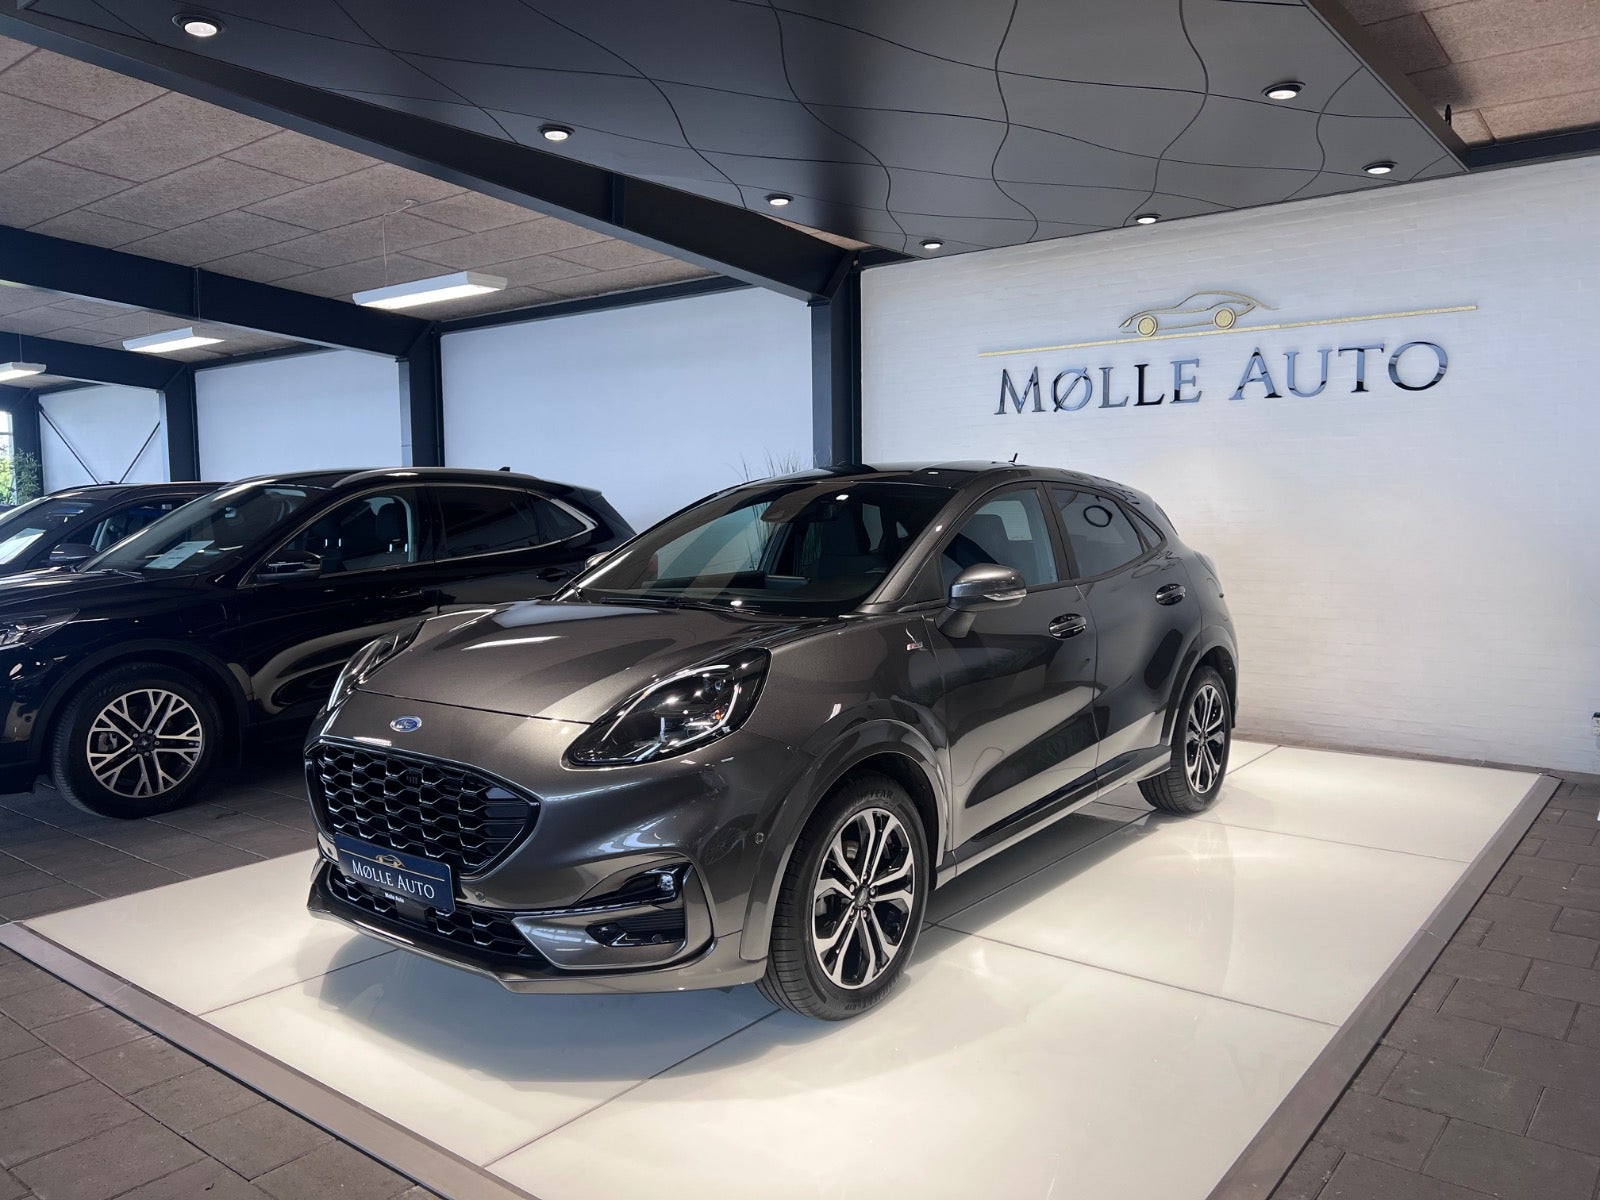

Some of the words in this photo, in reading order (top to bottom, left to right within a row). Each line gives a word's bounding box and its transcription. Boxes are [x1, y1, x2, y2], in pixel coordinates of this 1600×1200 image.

[994, 358, 1203, 415] MØLLE
[1228, 341, 1449, 401] AUTO
[352, 859, 394, 887] MØLLE
[397, 874, 435, 899] AUTO
